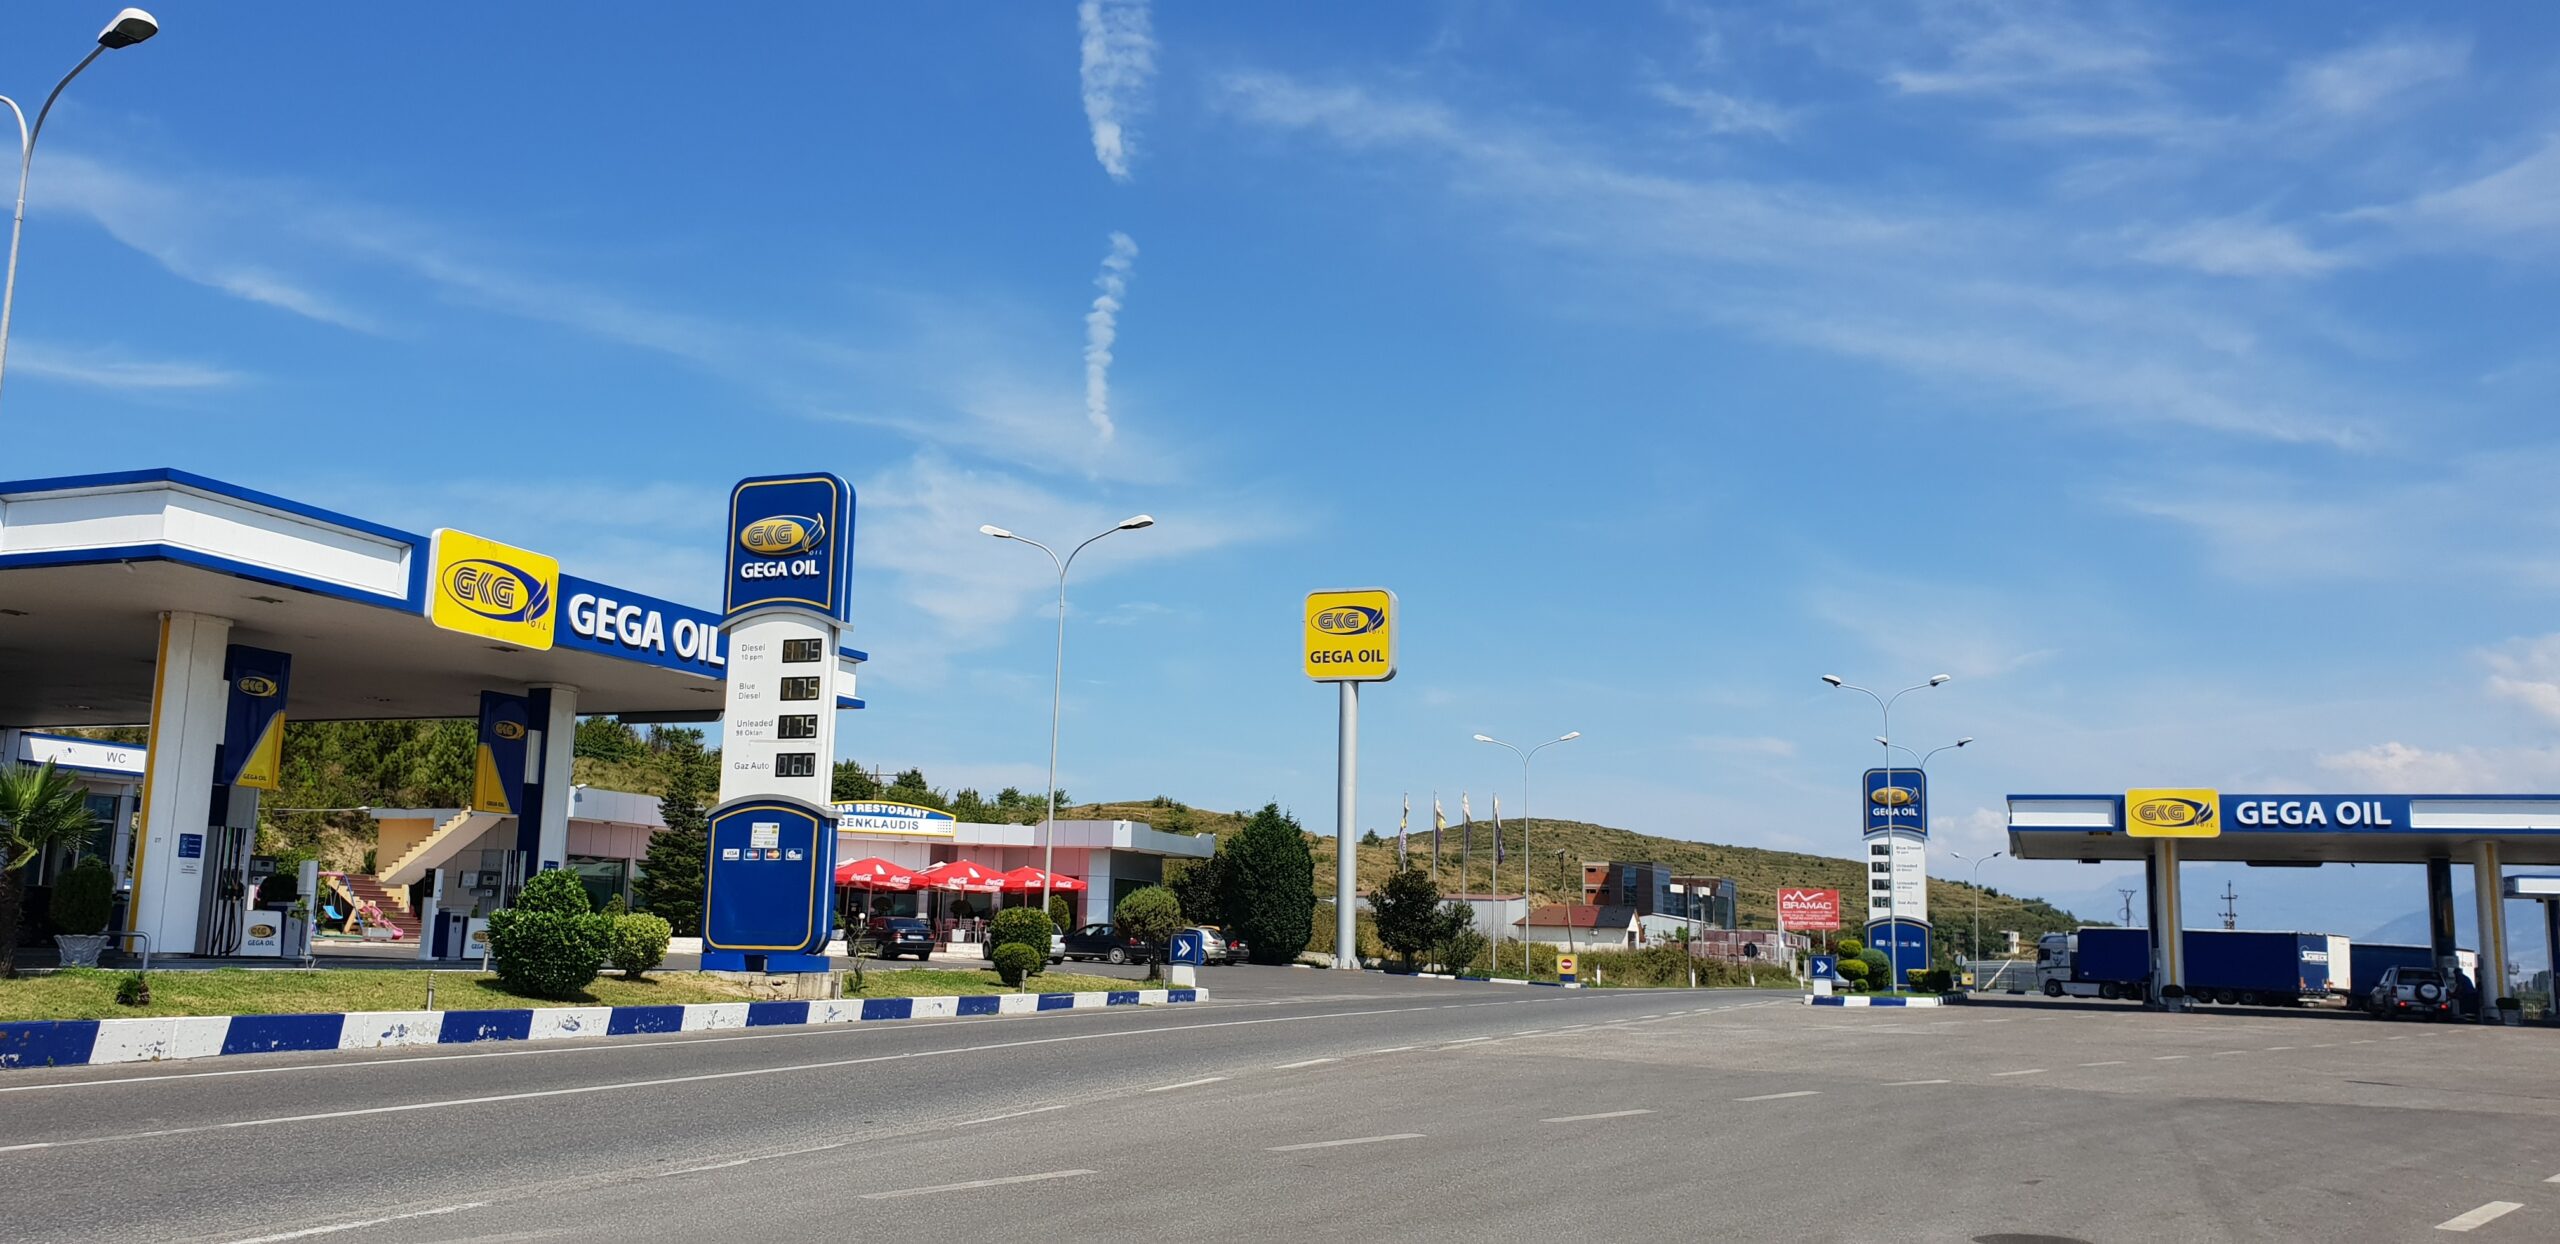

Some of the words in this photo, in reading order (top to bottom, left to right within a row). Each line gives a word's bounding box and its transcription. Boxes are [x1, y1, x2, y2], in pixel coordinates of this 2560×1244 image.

[748, 524, 792, 546] GKG
[741, 562, 788, 578] GEGA
[791, 560, 820, 576] OIL
[454, 567, 515, 610] GKG
[530, 620, 547, 630] OIL
[1318, 612, 1359, 629] GKG
[568, 593, 665, 651] GEGA
[672, 618, 725, 665] OIL
[741, 644, 766, 652] Diesel
[1310, 650, 1354, 664] GEGA
[1358, 649, 1384, 663] OIL
[738, 692, 761, 700] Diesel
[787, 679, 819, 699] 175
[737, 720, 774, 728] Unleaded
[784, 717, 816, 737] 175
[106, 751, 127, 764] WC
[777, 755, 815, 776] 060
[734, 762, 750, 770] Gaz
[751, 762, 770, 770] Auto
[856, 804, 930, 819] RESTORANT
[1901, 808, 1918, 816] OIL
[2139, 804, 2185, 821] GKG
[2236, 801, 2328, 825] GEGA
[2335, 801, 2392, 825] OIL
[1782, 901, 1832, 910] BRAMAC
